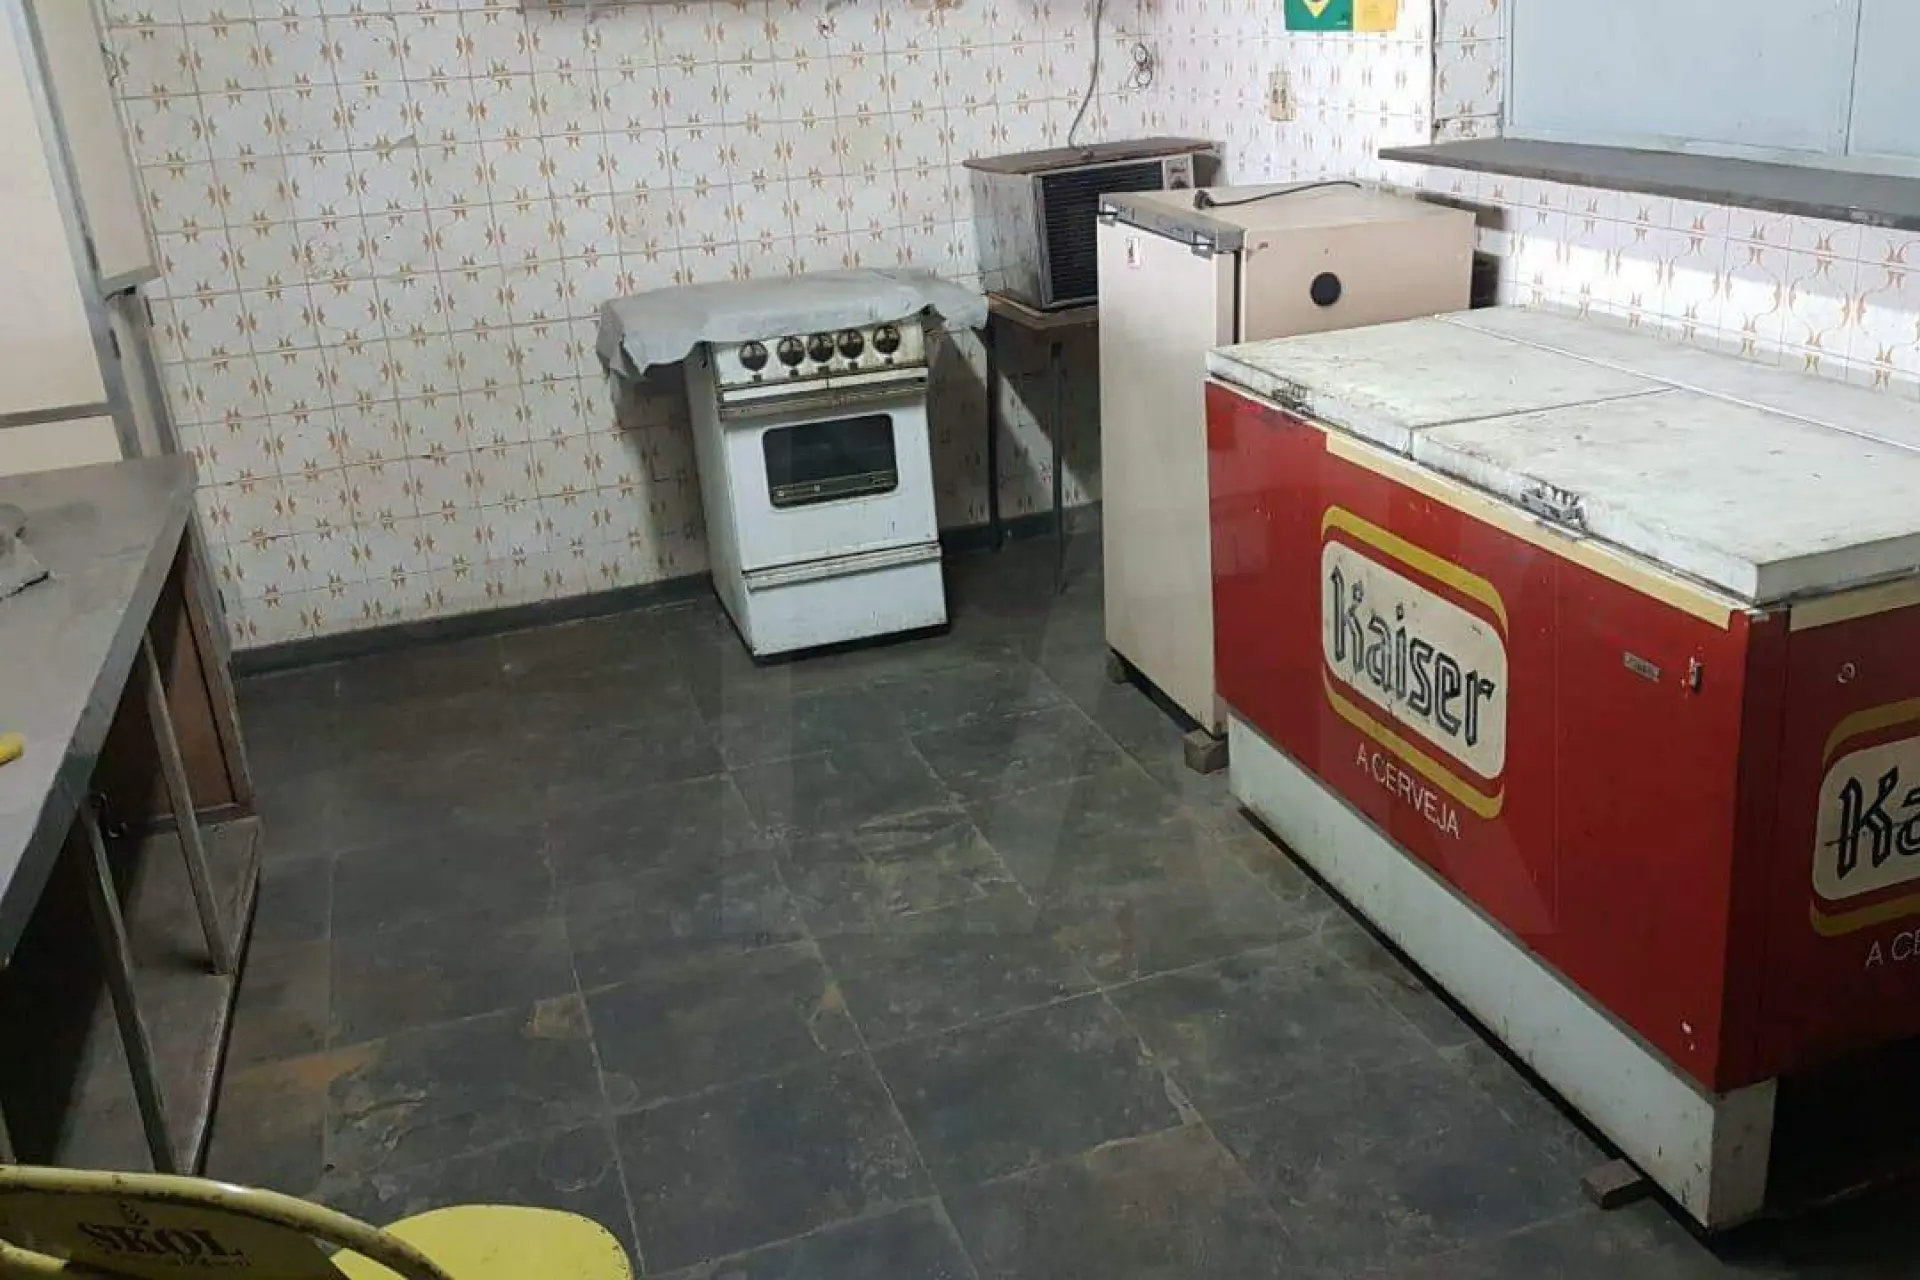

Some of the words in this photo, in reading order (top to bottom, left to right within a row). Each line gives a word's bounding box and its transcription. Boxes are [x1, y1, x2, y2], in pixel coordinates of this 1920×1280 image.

[1331, 565, 1495, 747] Kaiser
[1356, 743, 1369, 774] A
[1373, 752, 1461, 840] CERVEJA
[1865, 940, 1884, 967] A
